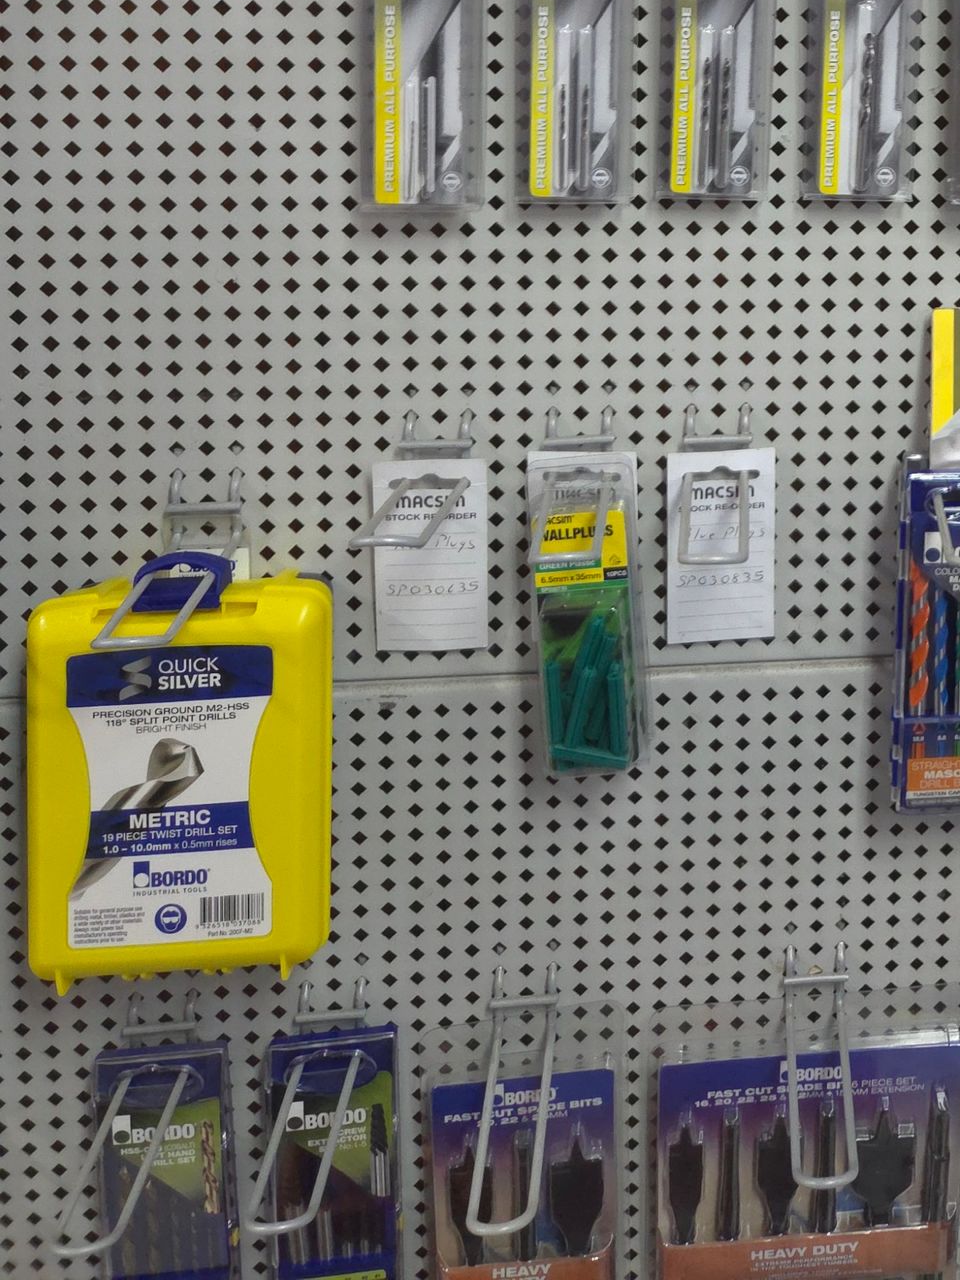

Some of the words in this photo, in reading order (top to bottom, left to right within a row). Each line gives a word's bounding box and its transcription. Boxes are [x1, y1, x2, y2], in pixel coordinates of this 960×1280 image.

[537, 7, 549, 82] PURPOSE
[537, 88, 547, 114] ALL
[536, 118, 547, 189] PREMIUM
[158, 656, 219, 672] QUICK
[157, 673, 222, 690] SILVER
[92, 709, 151, 718] PRECISION
[154, 705, 203, 715] GROUND
[206, 702, 250, 711] M2-HSS
[129, 716, 159, 725] SPLIT
[162, 714, 196, 724] POINT
[199, 712, 237, 721] DRILLS
[135, 725, 172, 734] BRIGHT
[175, 723, 207, 732] FINISH
[129, 810, 211, 829] METRIC
[102, 834, 114, 842] 19
[116, 832, 148, 842] PIECE
[150, 829, 183, 840] TWIST
[185, 827, 215, 837] DRILL
[217, 825, 238, 835] SET
[103, 845, 118, 854] 1.0
[130, 842, 172, 852] 10.0mm
[181, 840, 214, 849] 0.5mm
[216, 838, 238, 847] rises
[151, 870, 208, 887] BORDO
[707, 1089, 741, 1099] FAST
[745, 1085, 774, 1096] CUT
[570, 1097, 603, 1107] BITS
[751, 1246, 808, 1260] HEAVY
[812, 1241, 859, 1255] DUTY
